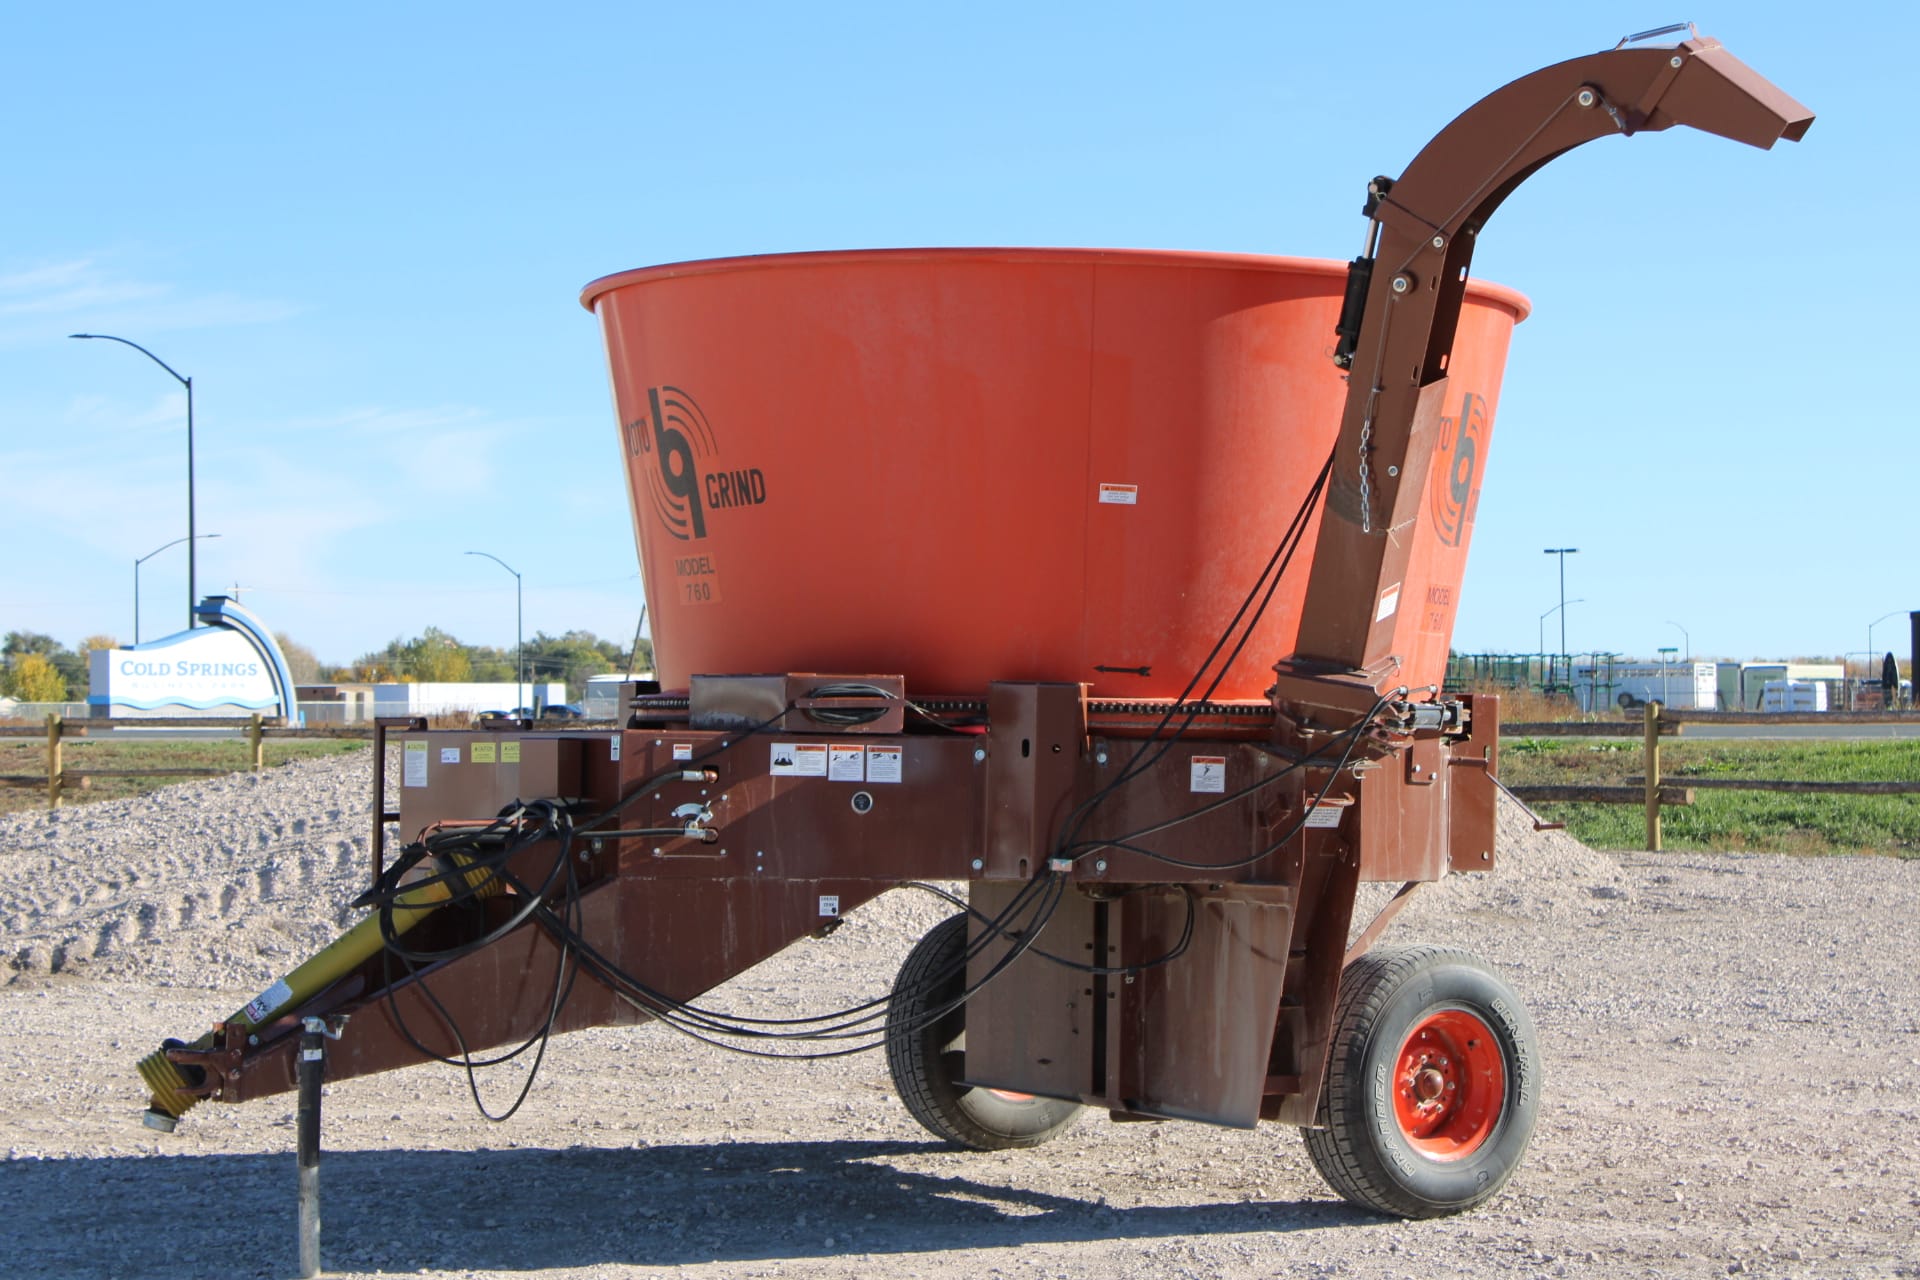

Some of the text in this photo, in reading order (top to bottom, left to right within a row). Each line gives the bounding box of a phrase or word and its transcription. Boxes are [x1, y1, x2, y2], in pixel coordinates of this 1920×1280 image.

[705, 468, 767, 509] GRIND
[675, 556, 715, 577] MODEL
[686, 582, 711, 601] 760
[120, 660, 258, 677] COLD SPRINGS
[1490, 998, 1529, 1107] GENERAL
[1375, 1063, 1416, 1178] GRABBER
